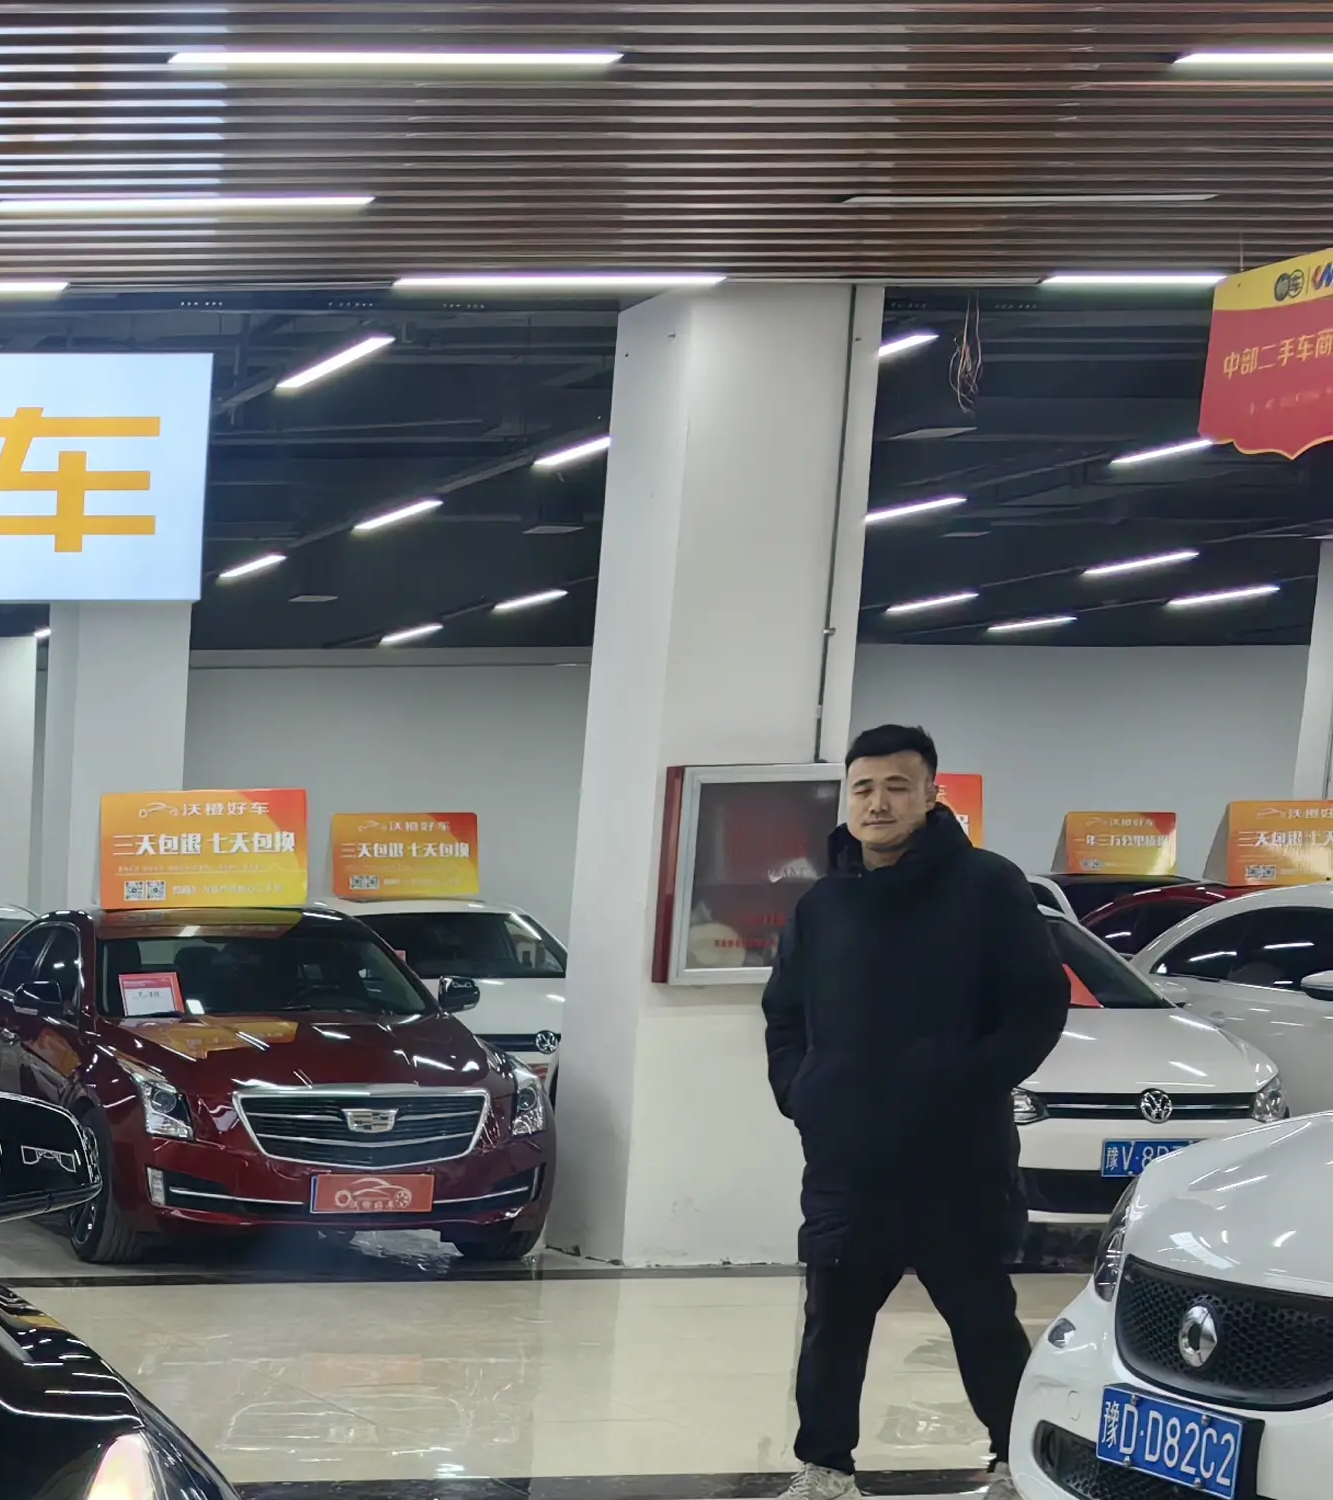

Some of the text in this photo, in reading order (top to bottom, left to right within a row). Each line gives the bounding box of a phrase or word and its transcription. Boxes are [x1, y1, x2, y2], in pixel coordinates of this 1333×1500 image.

[183, 801, 270, 817] 沃橙好车
[112, 829, 296, 857] 三天包退 七天包换
[1101, 1400, 1236, 1487] 豫D·D82C2
